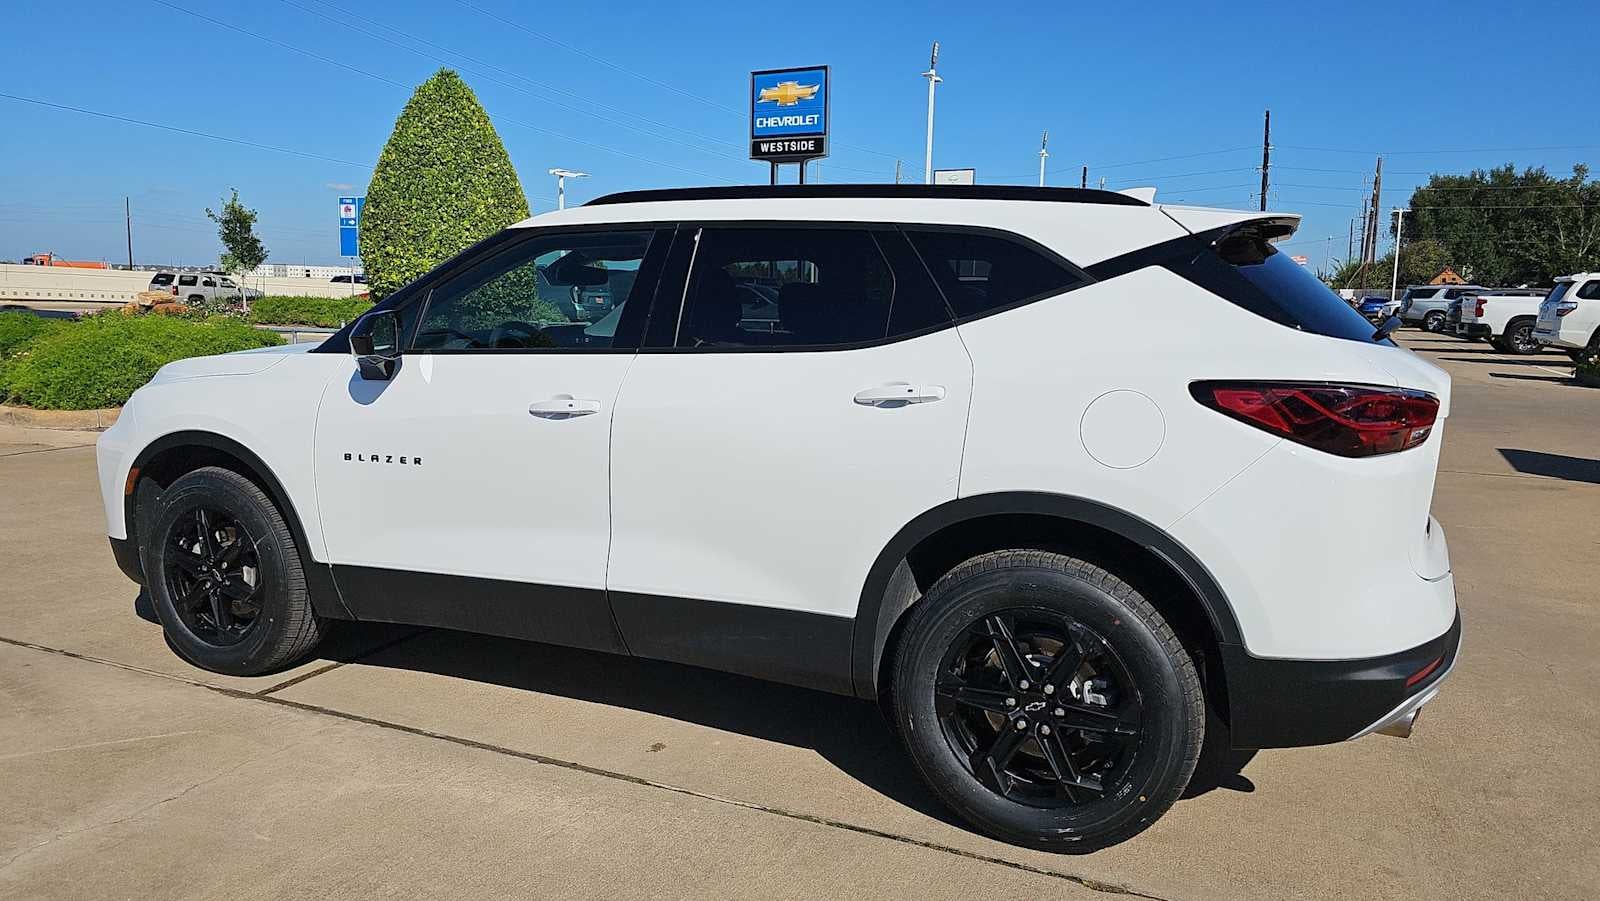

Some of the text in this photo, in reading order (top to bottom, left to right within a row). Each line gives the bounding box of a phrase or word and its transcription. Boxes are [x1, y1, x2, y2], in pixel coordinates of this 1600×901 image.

[756, 115, 819, 128] CHEVROLET
[760, 140, 815, 153] WESTSIDE
[344, 453, 422, 466] BLAZER
